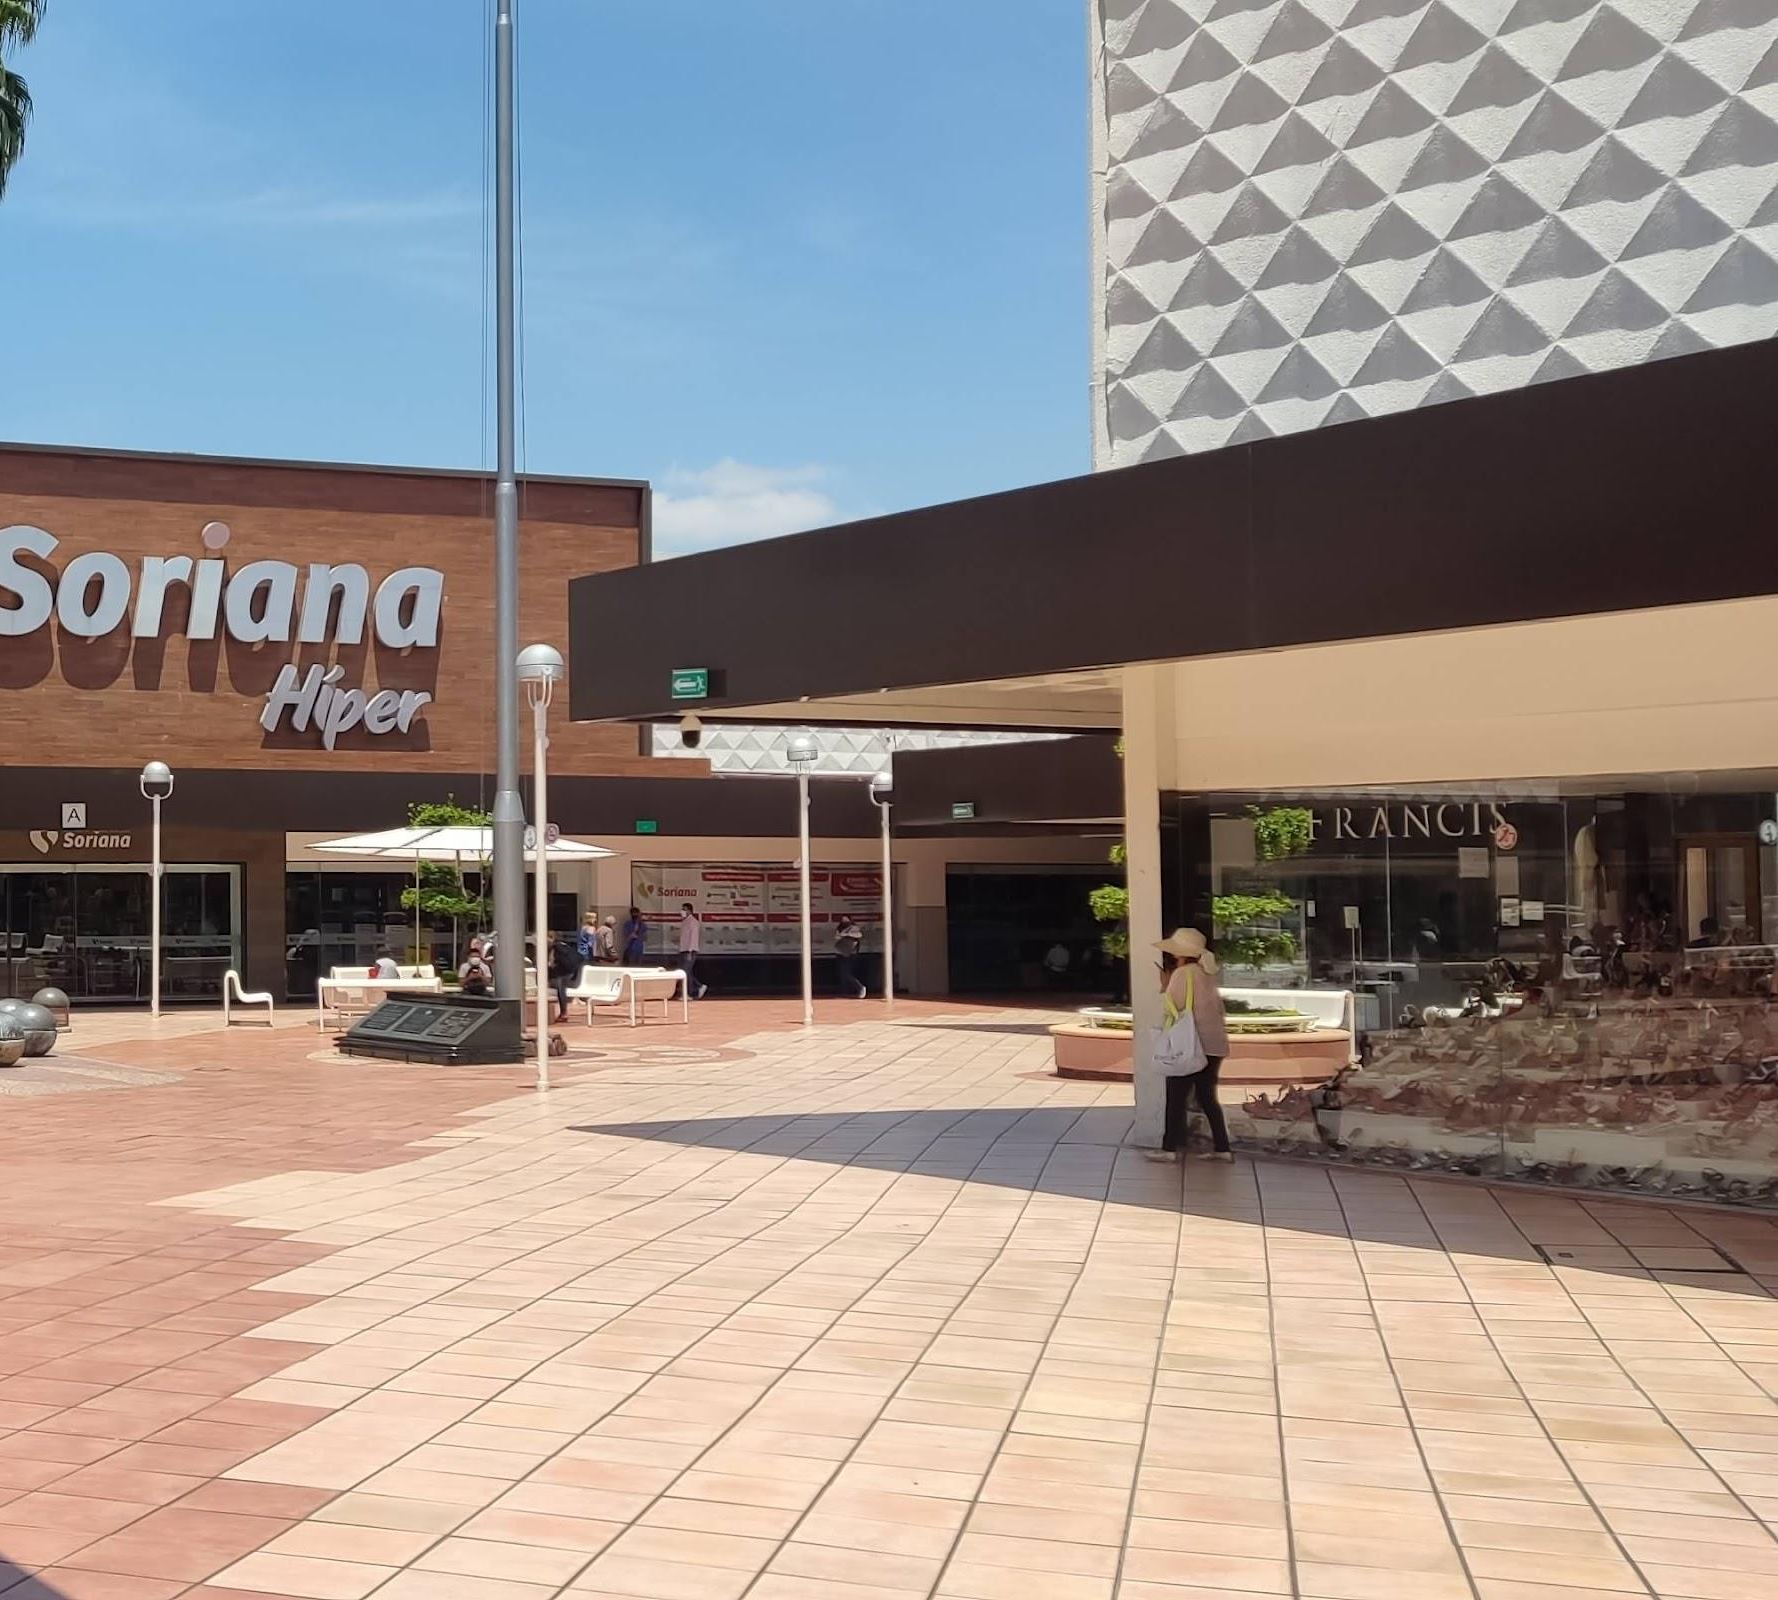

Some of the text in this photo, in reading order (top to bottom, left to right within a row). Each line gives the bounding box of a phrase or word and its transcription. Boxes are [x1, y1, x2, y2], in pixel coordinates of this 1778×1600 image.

[260, 663, 433, 752] Híper
[67, 808, 81, 822] A
[1308, 801, 1508, 841] FRANCIS
[63, 831, 131, 848] Soriana
[657, 886, 698, 897] Soriana
